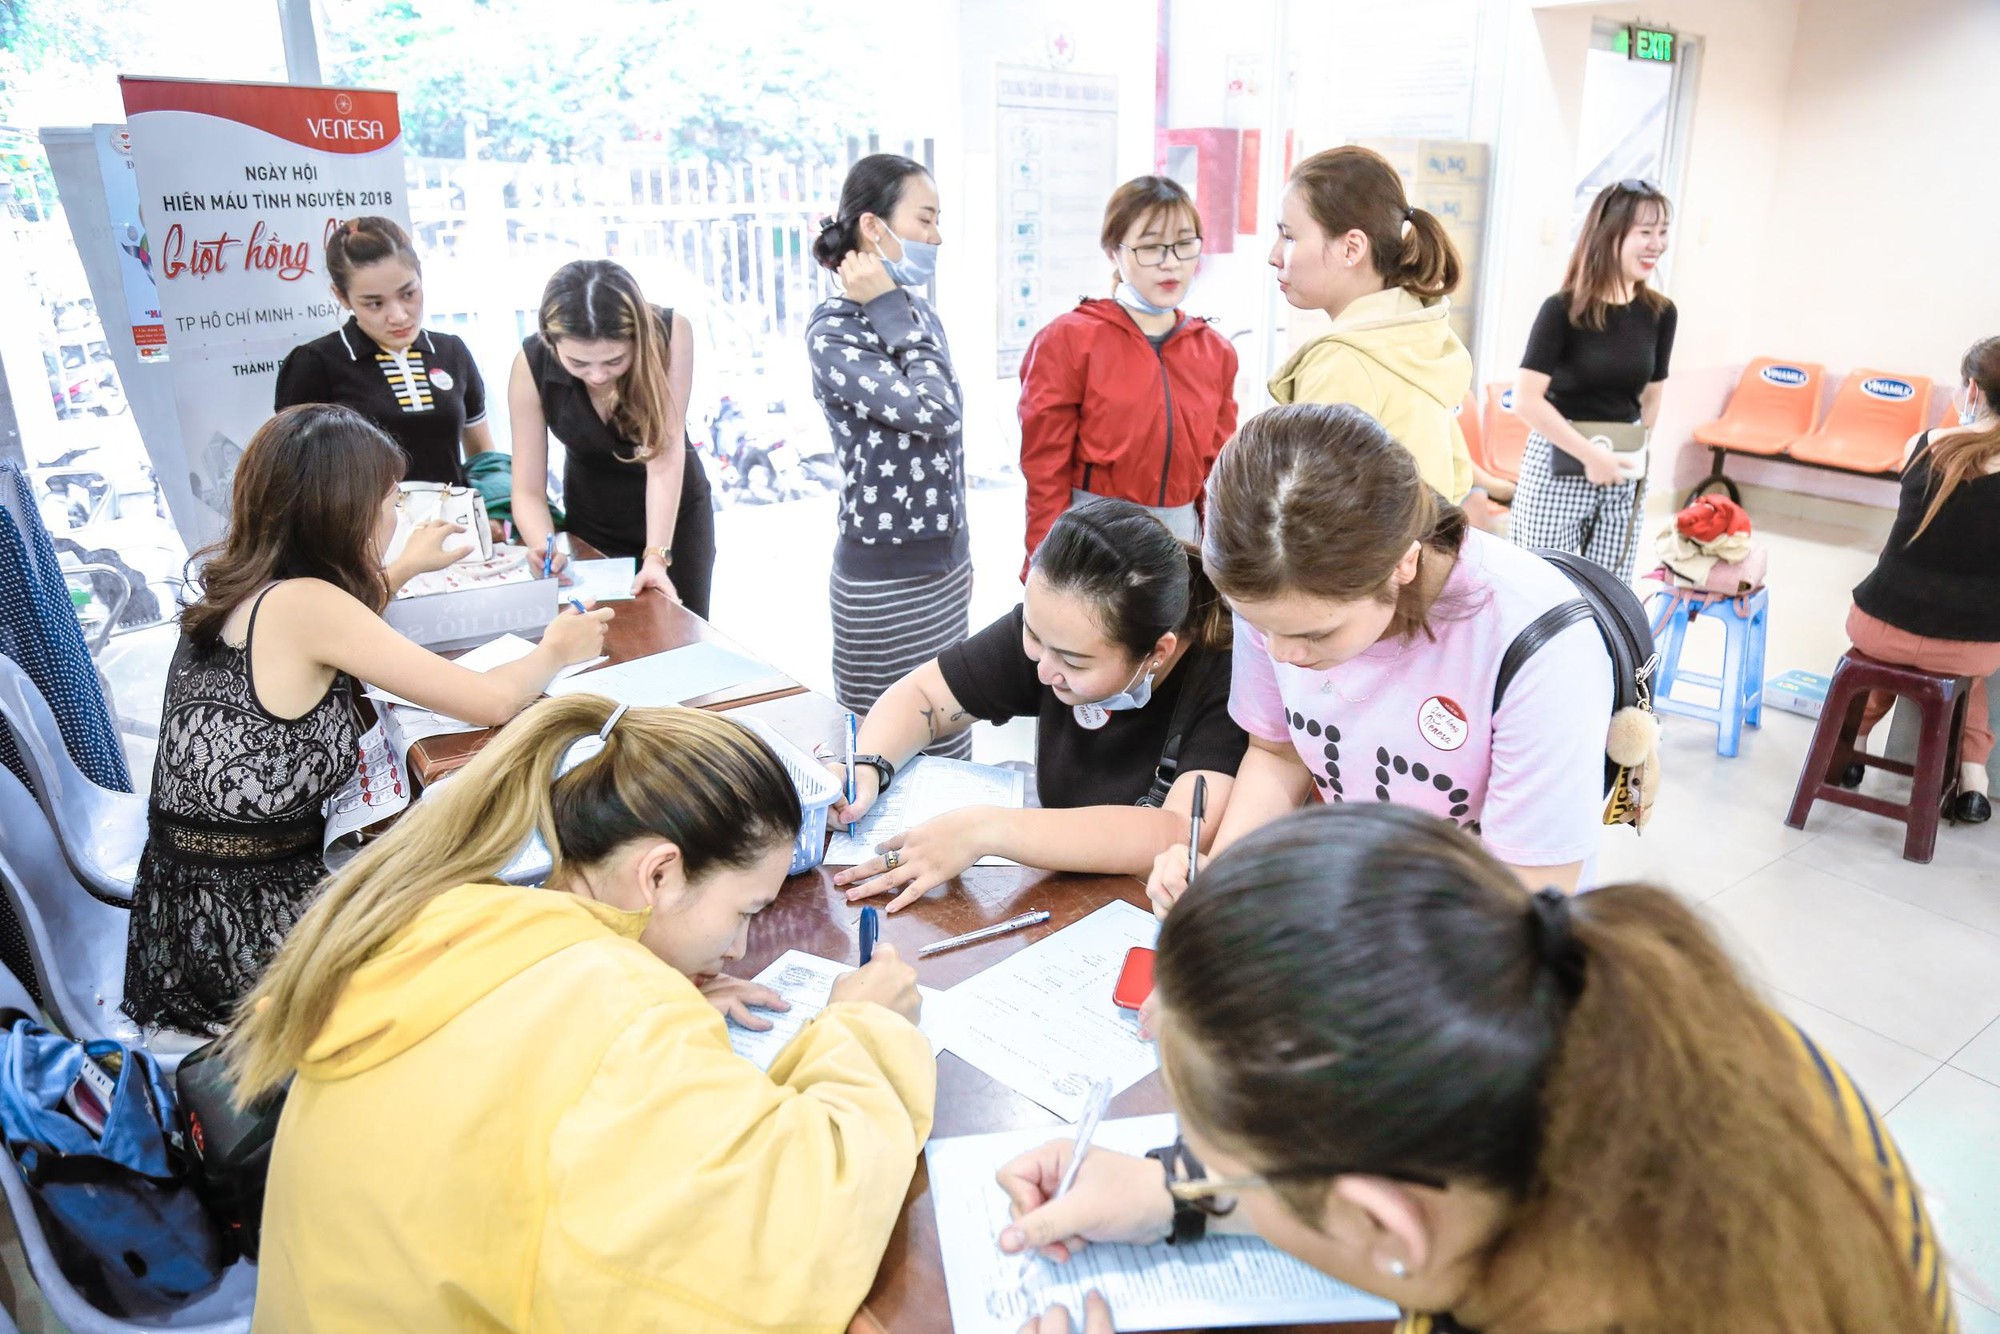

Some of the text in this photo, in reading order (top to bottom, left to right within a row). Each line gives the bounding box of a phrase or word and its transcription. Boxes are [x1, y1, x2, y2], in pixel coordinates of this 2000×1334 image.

[1637, 30, 1674, 62] EXIT
[307, 118, 385, 140] VENESA
[245, 162, 318, 184] NGÀY HỘI
[211, 190, 248, 210] MÁU
[253, 190, 291, 209] TÌNH
[296, 188, 355, 210] NGUYỆN
[360, 191, 393, 206] 2018
[163, 223, 242, 281] Giọt
[244, 220, 315, 281] hồng
[176, 317, 196, 332] TP
[225, 308, 251, 327] CHÍ
[255, 307, 294, 323] MINH
[233, 361, 275, 376] THÀNH
